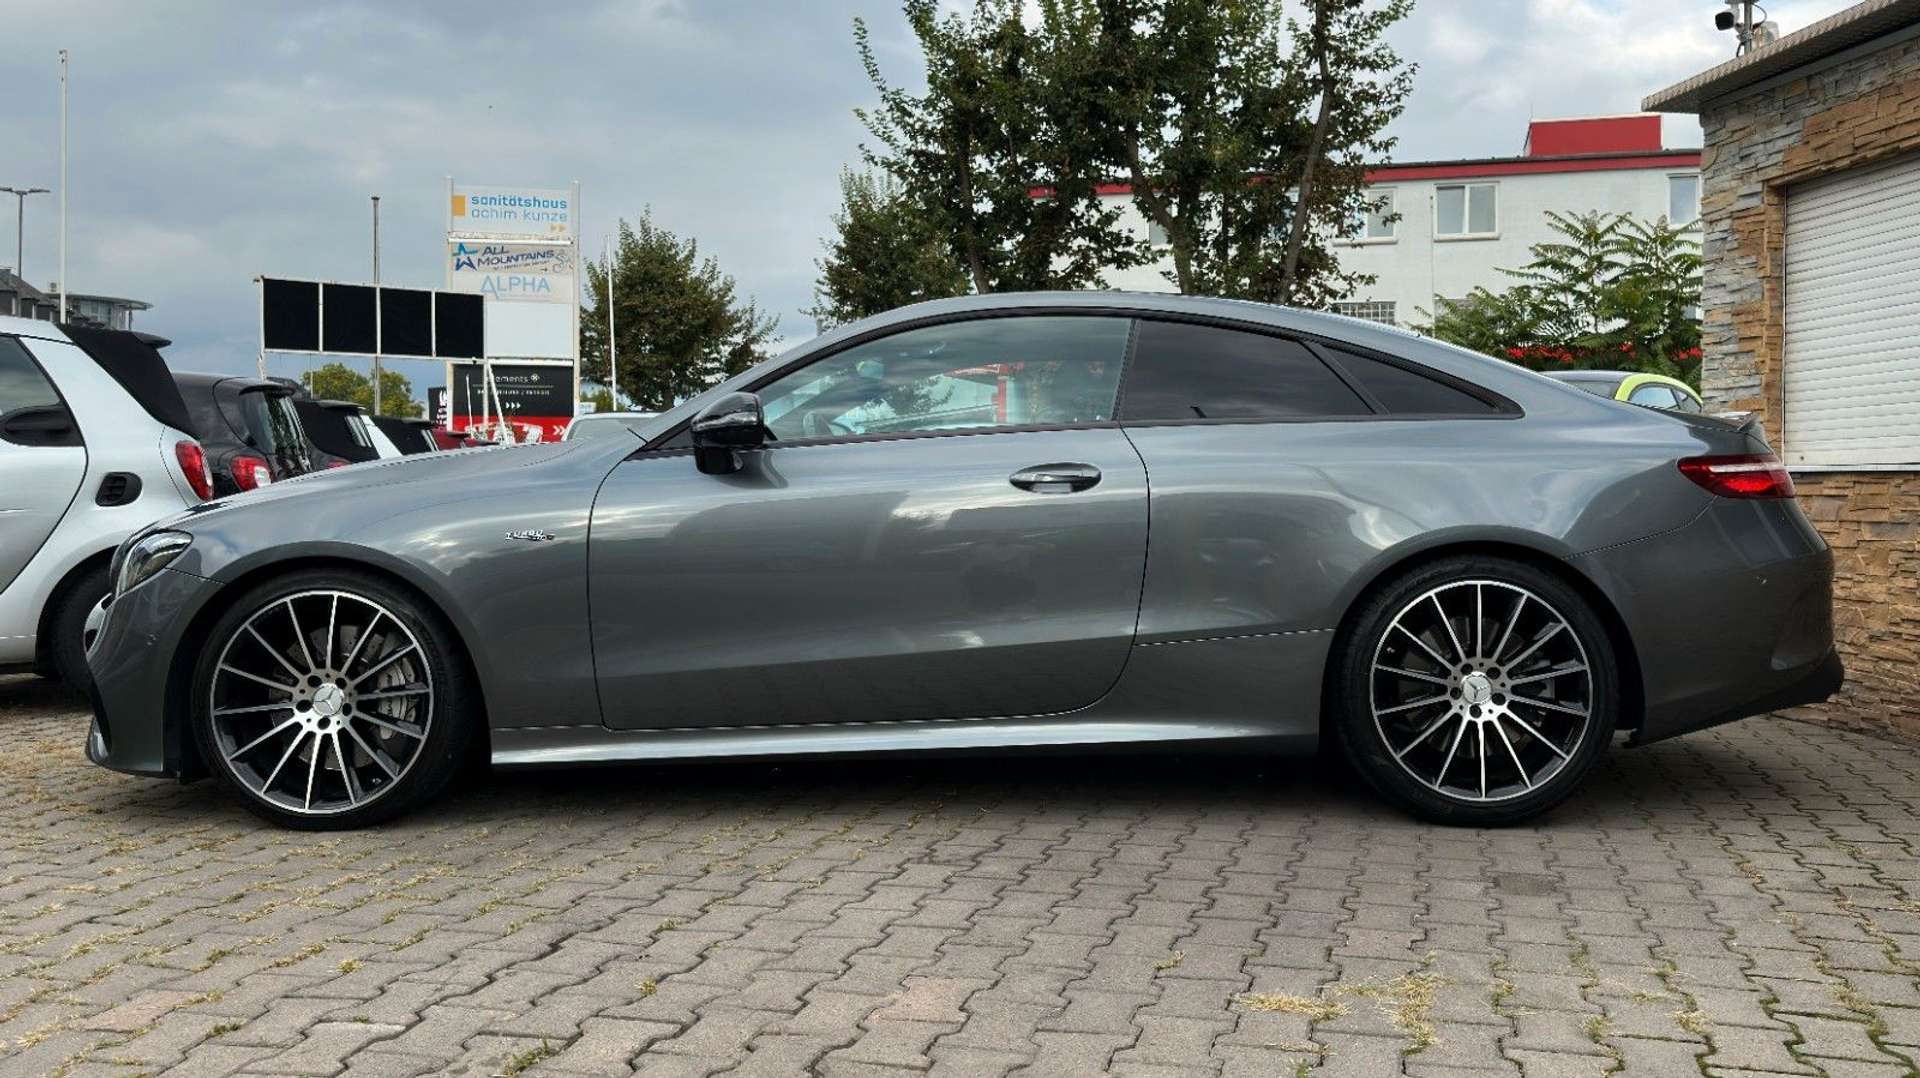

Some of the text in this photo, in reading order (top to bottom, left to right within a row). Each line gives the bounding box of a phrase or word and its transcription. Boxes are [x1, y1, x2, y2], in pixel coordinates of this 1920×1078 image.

[471, 194, 568, 209] sanitätshaus
[471, 208, 568, 222] achim kunze
[477, 249, 555, 267] MOUNTAINS
[482, 245, 510, 257] ALL
[480, 275, 551, 297] ALPHA
[491, 375, 529, 383] ements
